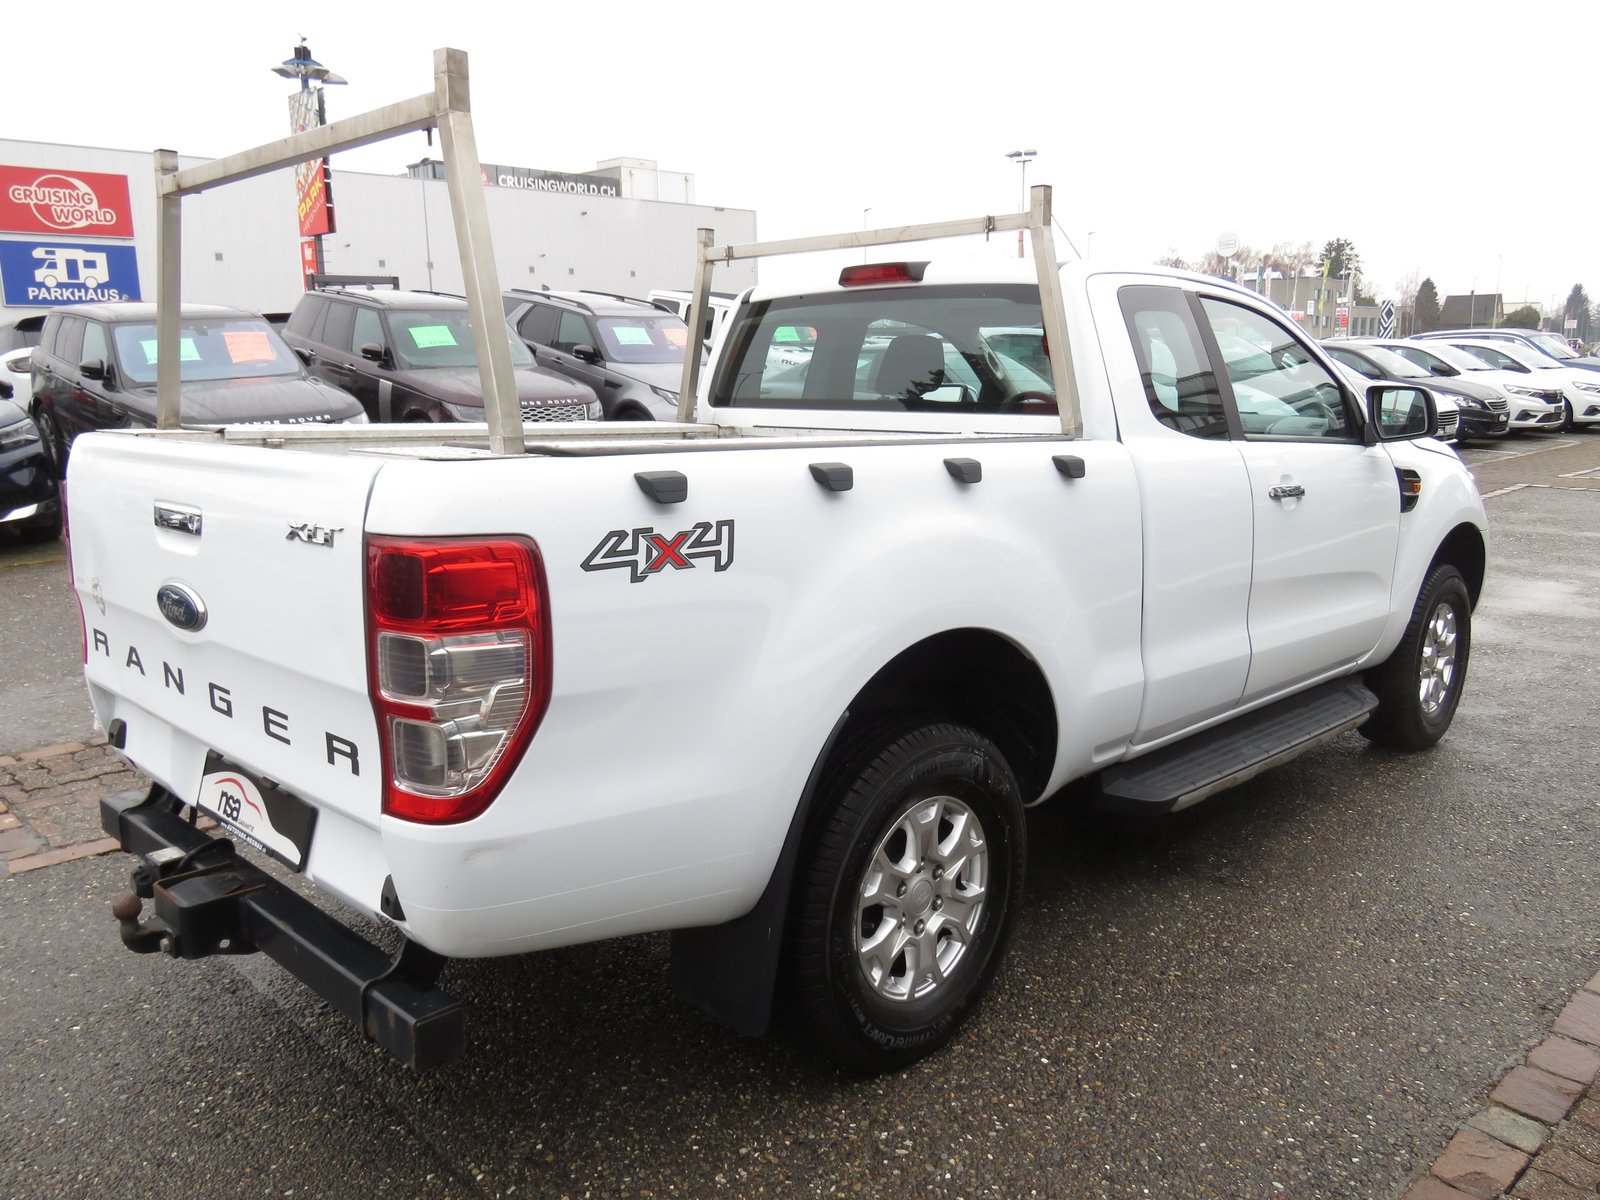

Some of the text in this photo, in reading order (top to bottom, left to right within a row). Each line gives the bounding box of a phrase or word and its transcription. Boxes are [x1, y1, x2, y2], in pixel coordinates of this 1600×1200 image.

[9, 186, 95, 206] CRUISING
[298, 175, 323, 221] PARK
[498, 174, 616, 197] CRUISINGWORLD.CH
[52, 206, 116, 225] WORLD
[28, 287, 119, 301] PARKHAUS
[289, 415, 331, 424] ROVER
[286, 520, 343, 548] XLT
[162, 590, 187, 622] Ford
[93, 627, 361, 777] RANGER
[218, 789, 242, 823] nsa
